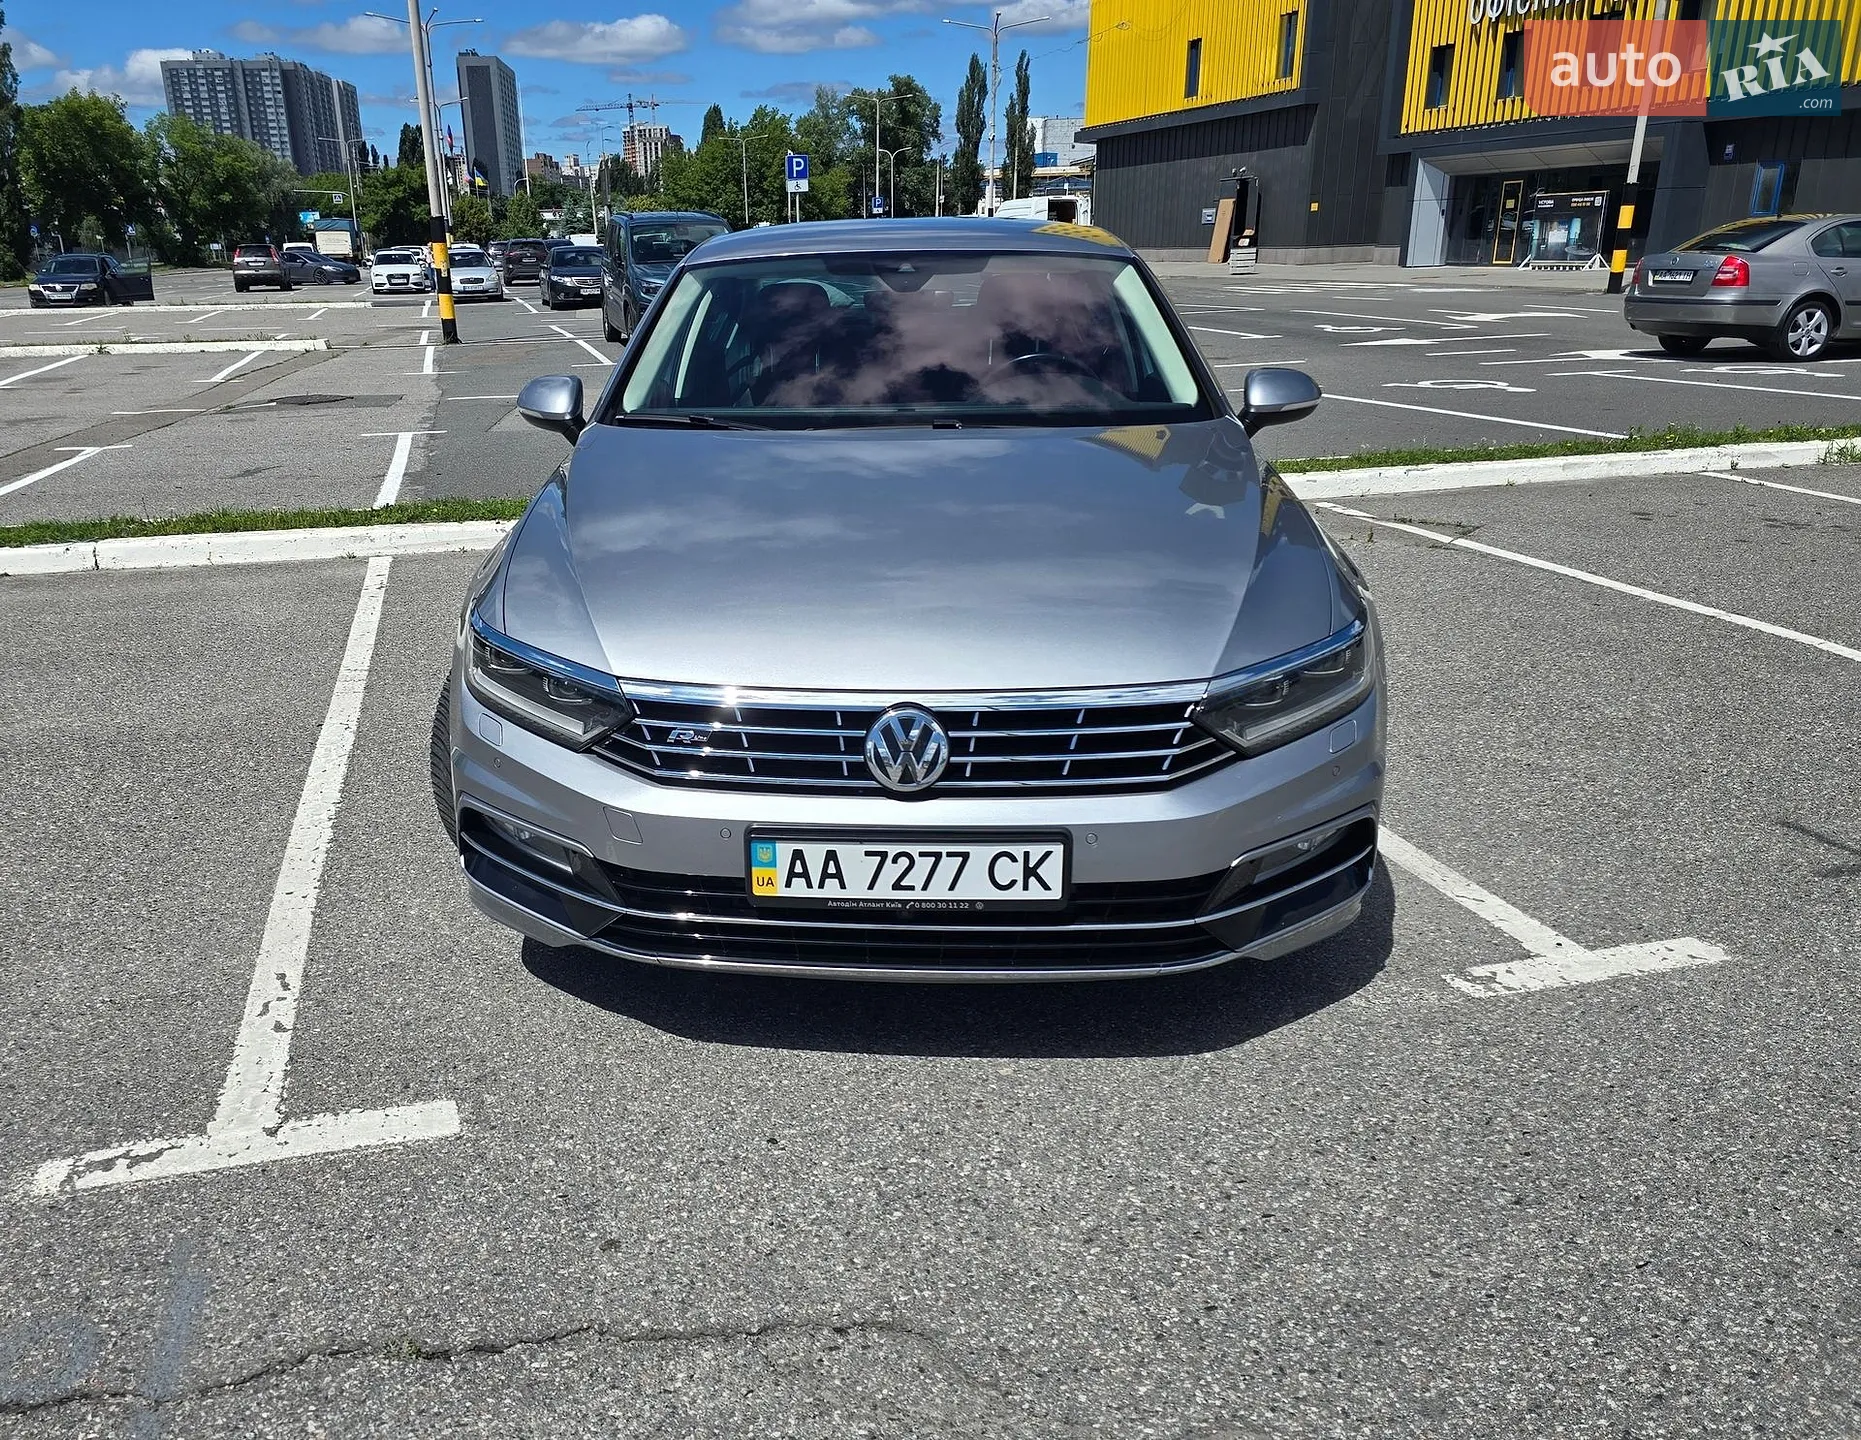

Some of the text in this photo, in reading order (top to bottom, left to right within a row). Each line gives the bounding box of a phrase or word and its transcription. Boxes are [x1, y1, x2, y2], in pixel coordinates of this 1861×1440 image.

[792, 158, 804, 177] P
[784, 848, 1054, 892] AA 7277 CK
[756, 876, 775, 888] UA
